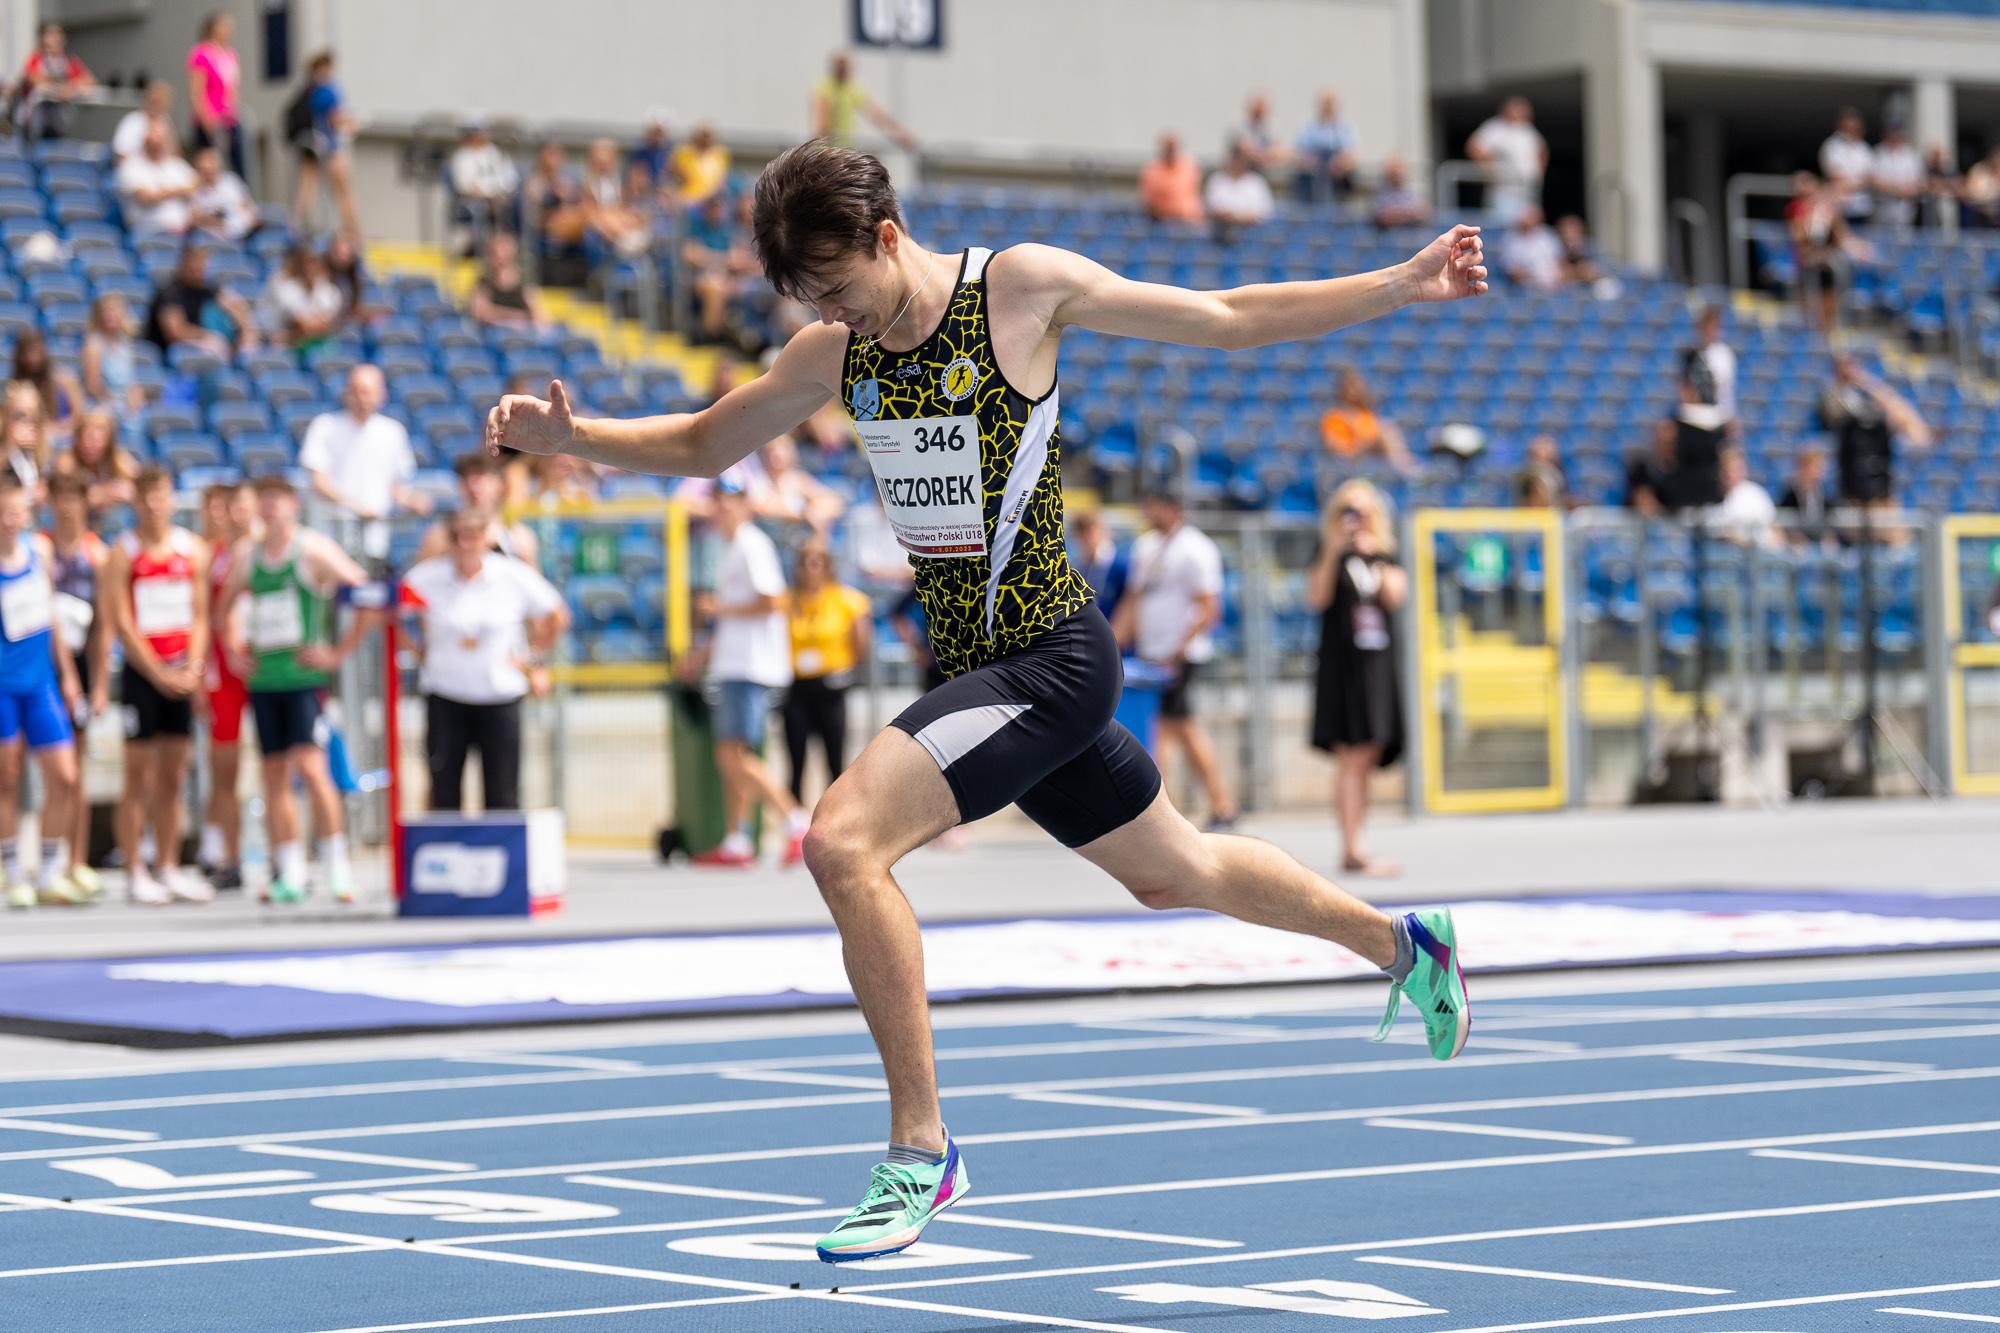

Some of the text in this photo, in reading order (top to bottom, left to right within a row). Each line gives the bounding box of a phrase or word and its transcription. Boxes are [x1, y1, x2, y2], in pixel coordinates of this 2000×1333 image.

[881, 440, 901, 449] Turystyki
[913, 424, 965, 454] 346
[937, 531, 963, 541] Polski
[965, 530, 983, 540] U18
[1093, 1279, 1449, 1319] 4
